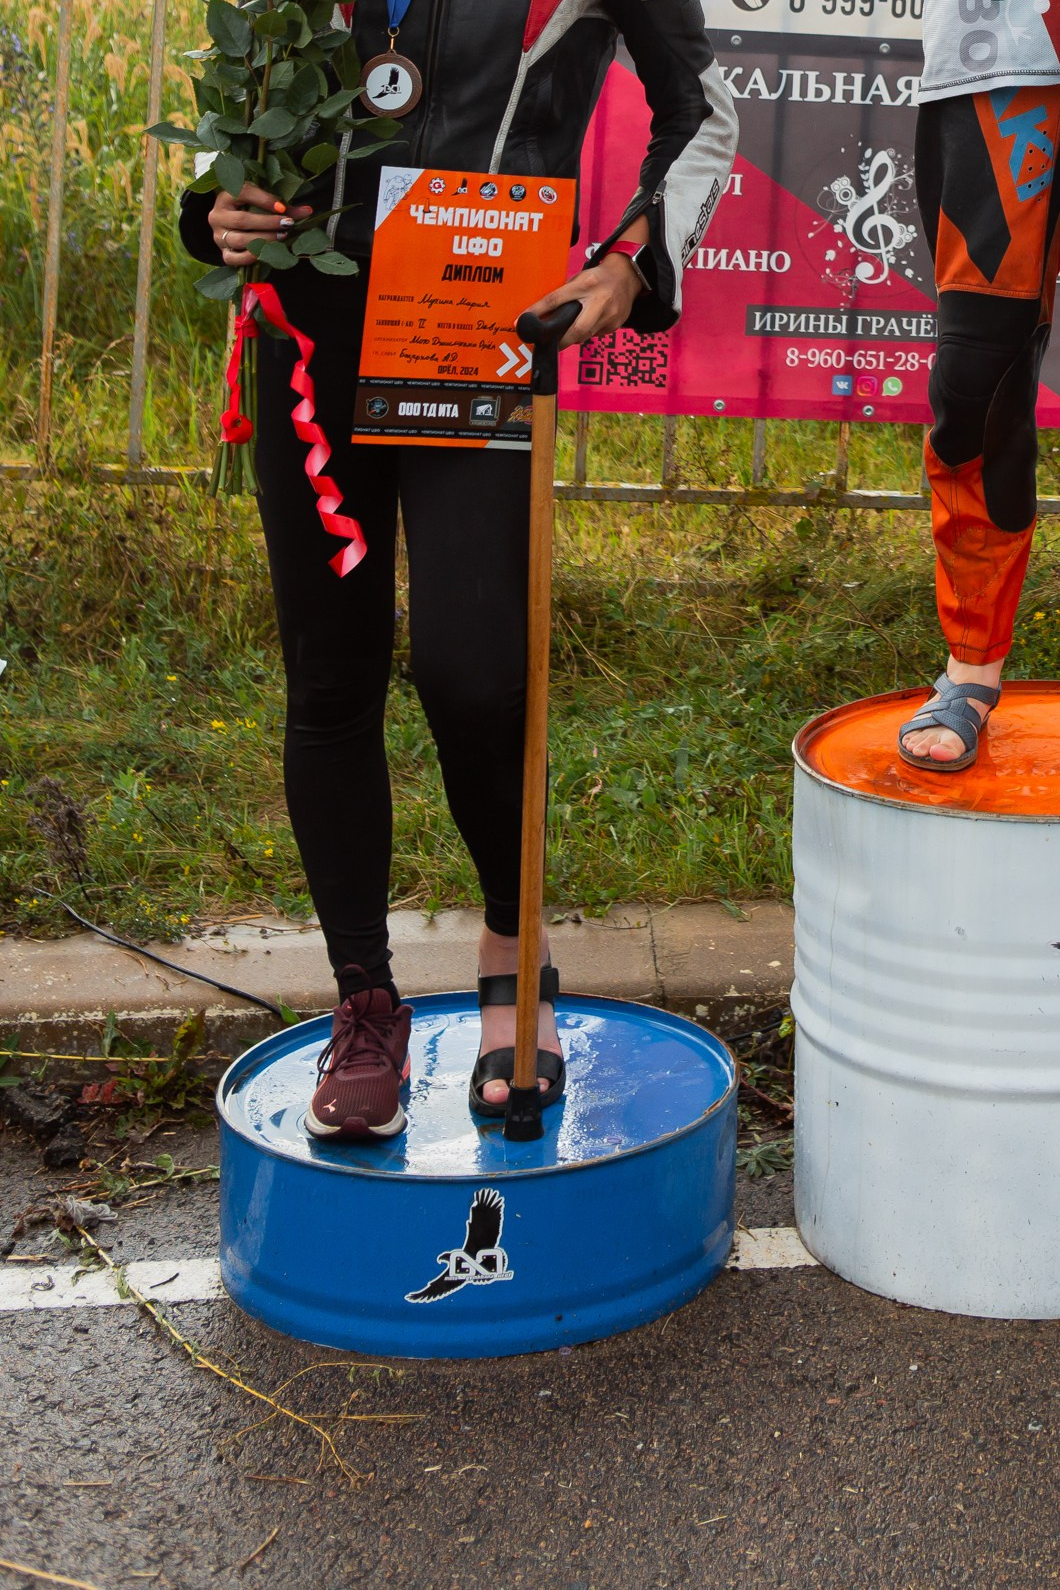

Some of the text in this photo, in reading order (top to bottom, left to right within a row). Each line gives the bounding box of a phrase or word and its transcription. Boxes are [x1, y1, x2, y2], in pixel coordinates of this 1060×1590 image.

[718, 66, 922, 107] КАЛЬНАЯ
[410, 204, 544, 232] ЧЕМПИОНАТ
[452, 235, 503, 257] ЦФО
[441, 264, 504, 284] ДИПЛОМ
[378, 293, 491, 311] НАГРАЖДАЕТСЯ Мухина Мария
[753, 311, 848, 334] ИРИНЫ
[460, 366, 479, 376] 2024
[398, 402, 459, 418] ООО ТД ИТА
